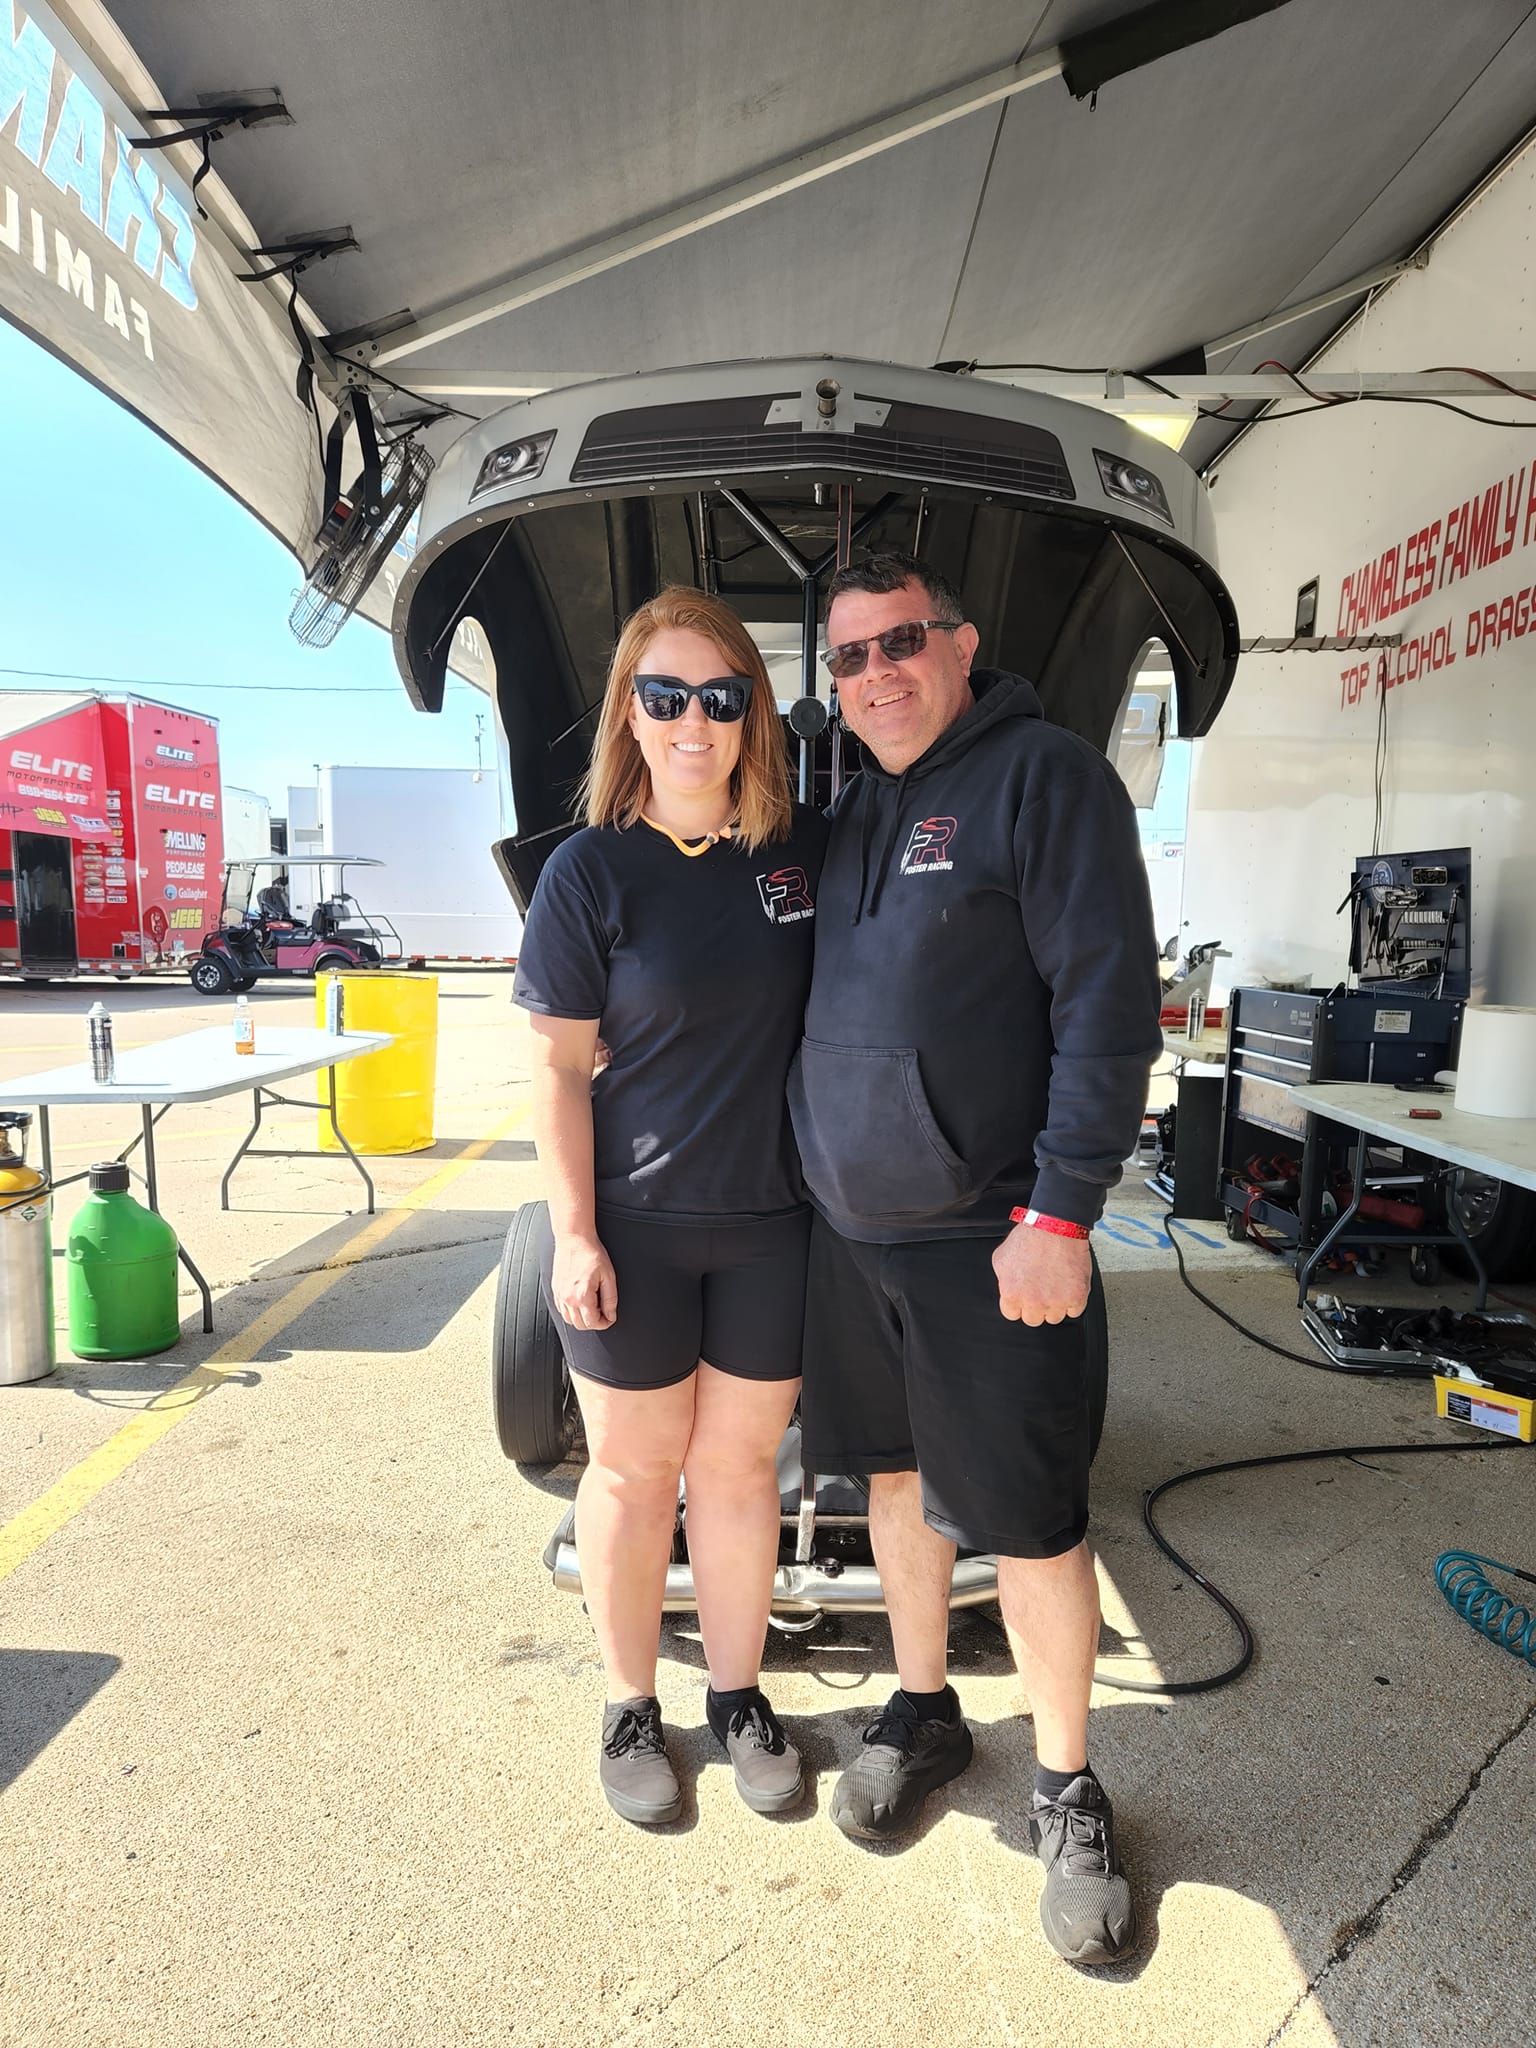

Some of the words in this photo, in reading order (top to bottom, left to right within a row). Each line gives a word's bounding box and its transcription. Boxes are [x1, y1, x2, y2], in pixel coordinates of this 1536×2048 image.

[1337, 518, 1442, 638] CHAMBLESS
[1438, 466, 1526, 591] FAMILY
[1340, 661, 1370, 712] TOP
[1375, 616, 1457, 700] ALCOHOL
[156, 744, 194, 762] ELITE
[10, 750, 93, 782] ELITE
[145, 783, 216, 810] ELITE
[167, 829, 206, 851] MELLING
[165, 860, 205, 875] PEOPLEASE
[904, 863, 928, 875] FOSTER
[927, 860, 954, 872] RACING
[178, 887, 208, 901] Gallagher
[172, 908, 203, 929] JEGS
[778, 911, 802, 924] FOSTER
